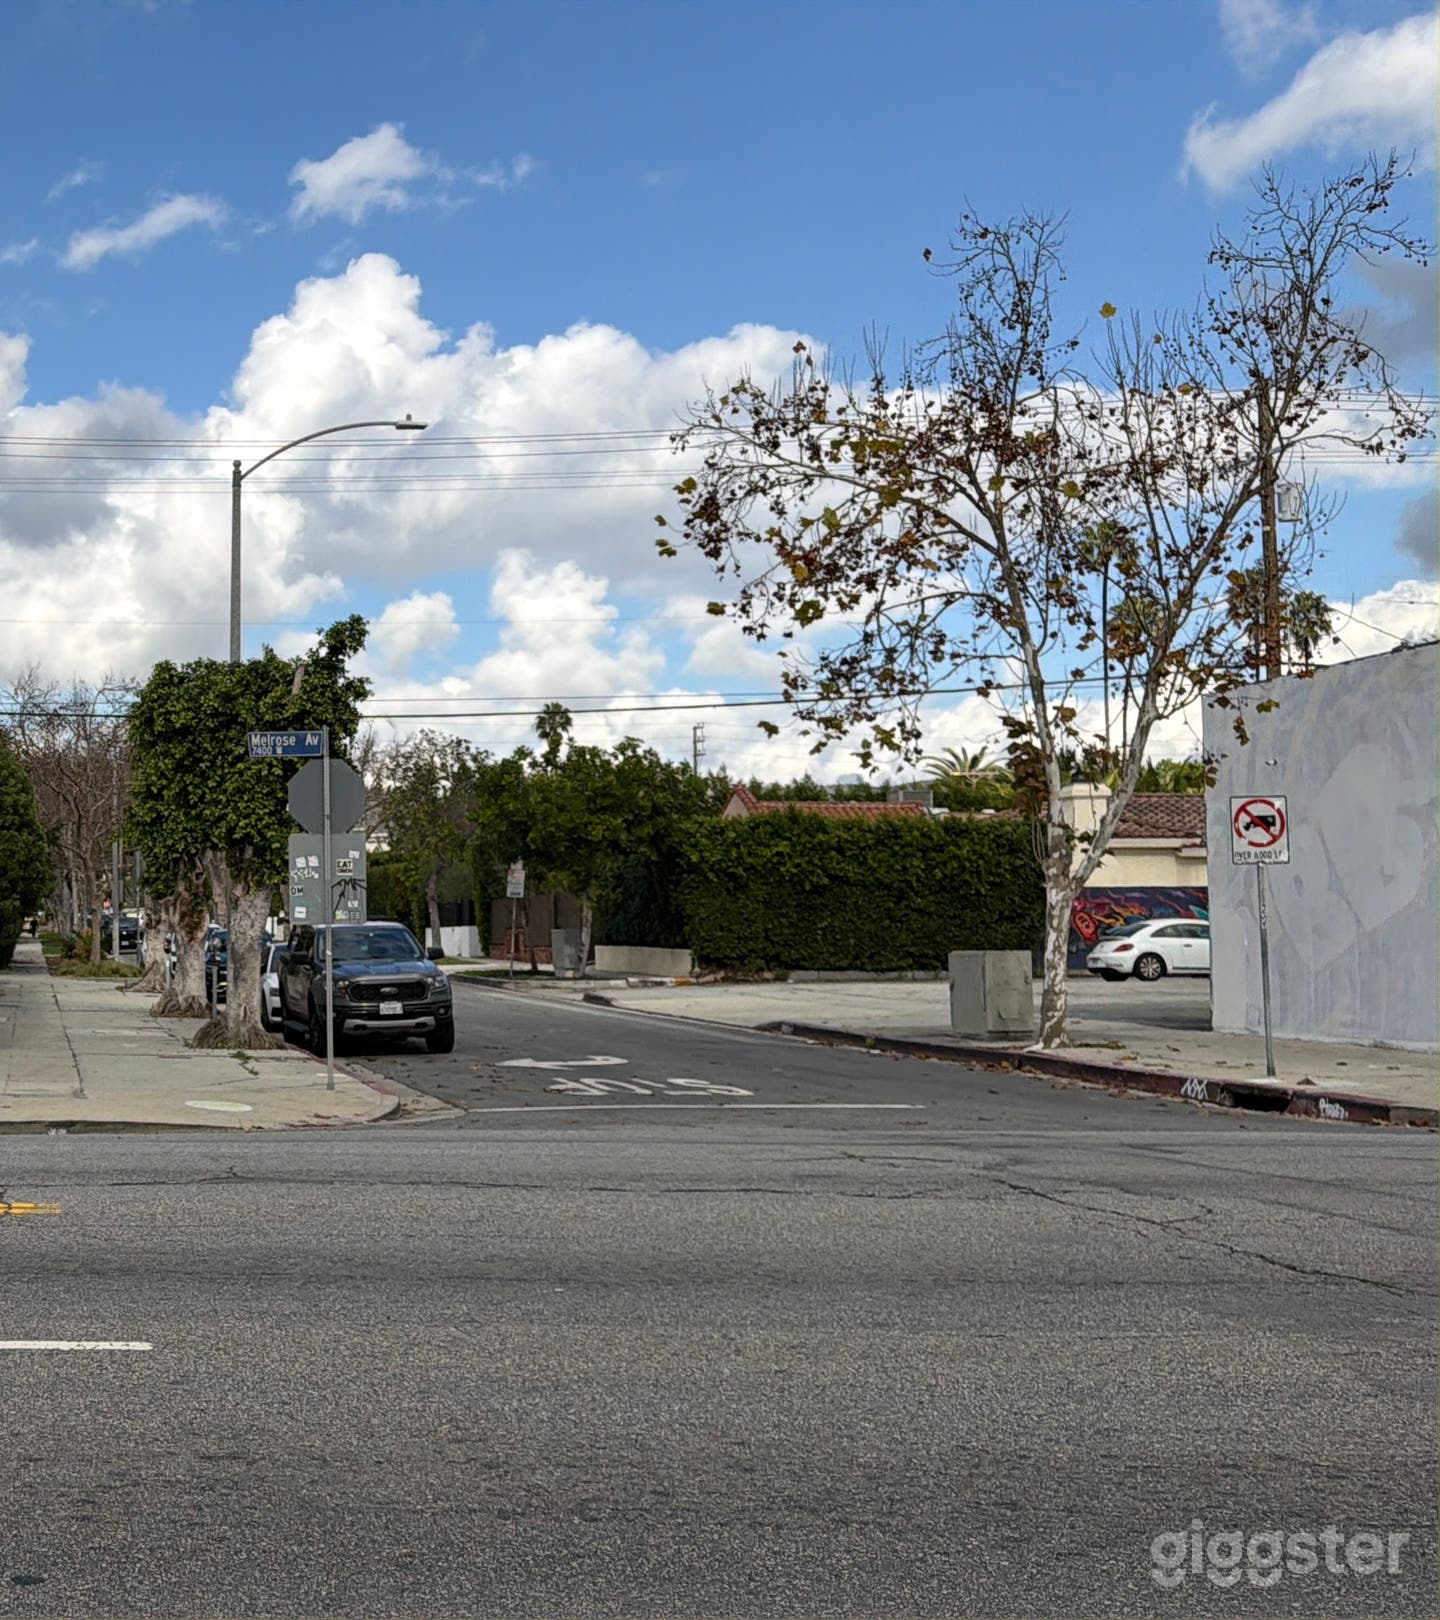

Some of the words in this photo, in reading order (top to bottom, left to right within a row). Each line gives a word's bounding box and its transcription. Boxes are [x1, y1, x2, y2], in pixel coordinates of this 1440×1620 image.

[251, 734, 296, 746] Melrose
[305, 733, 319, 746] Av
[252, 746, 272, 755] 7400
[275, 746, 283, 754] W
[1234, 850, 1252, 861] OVER
